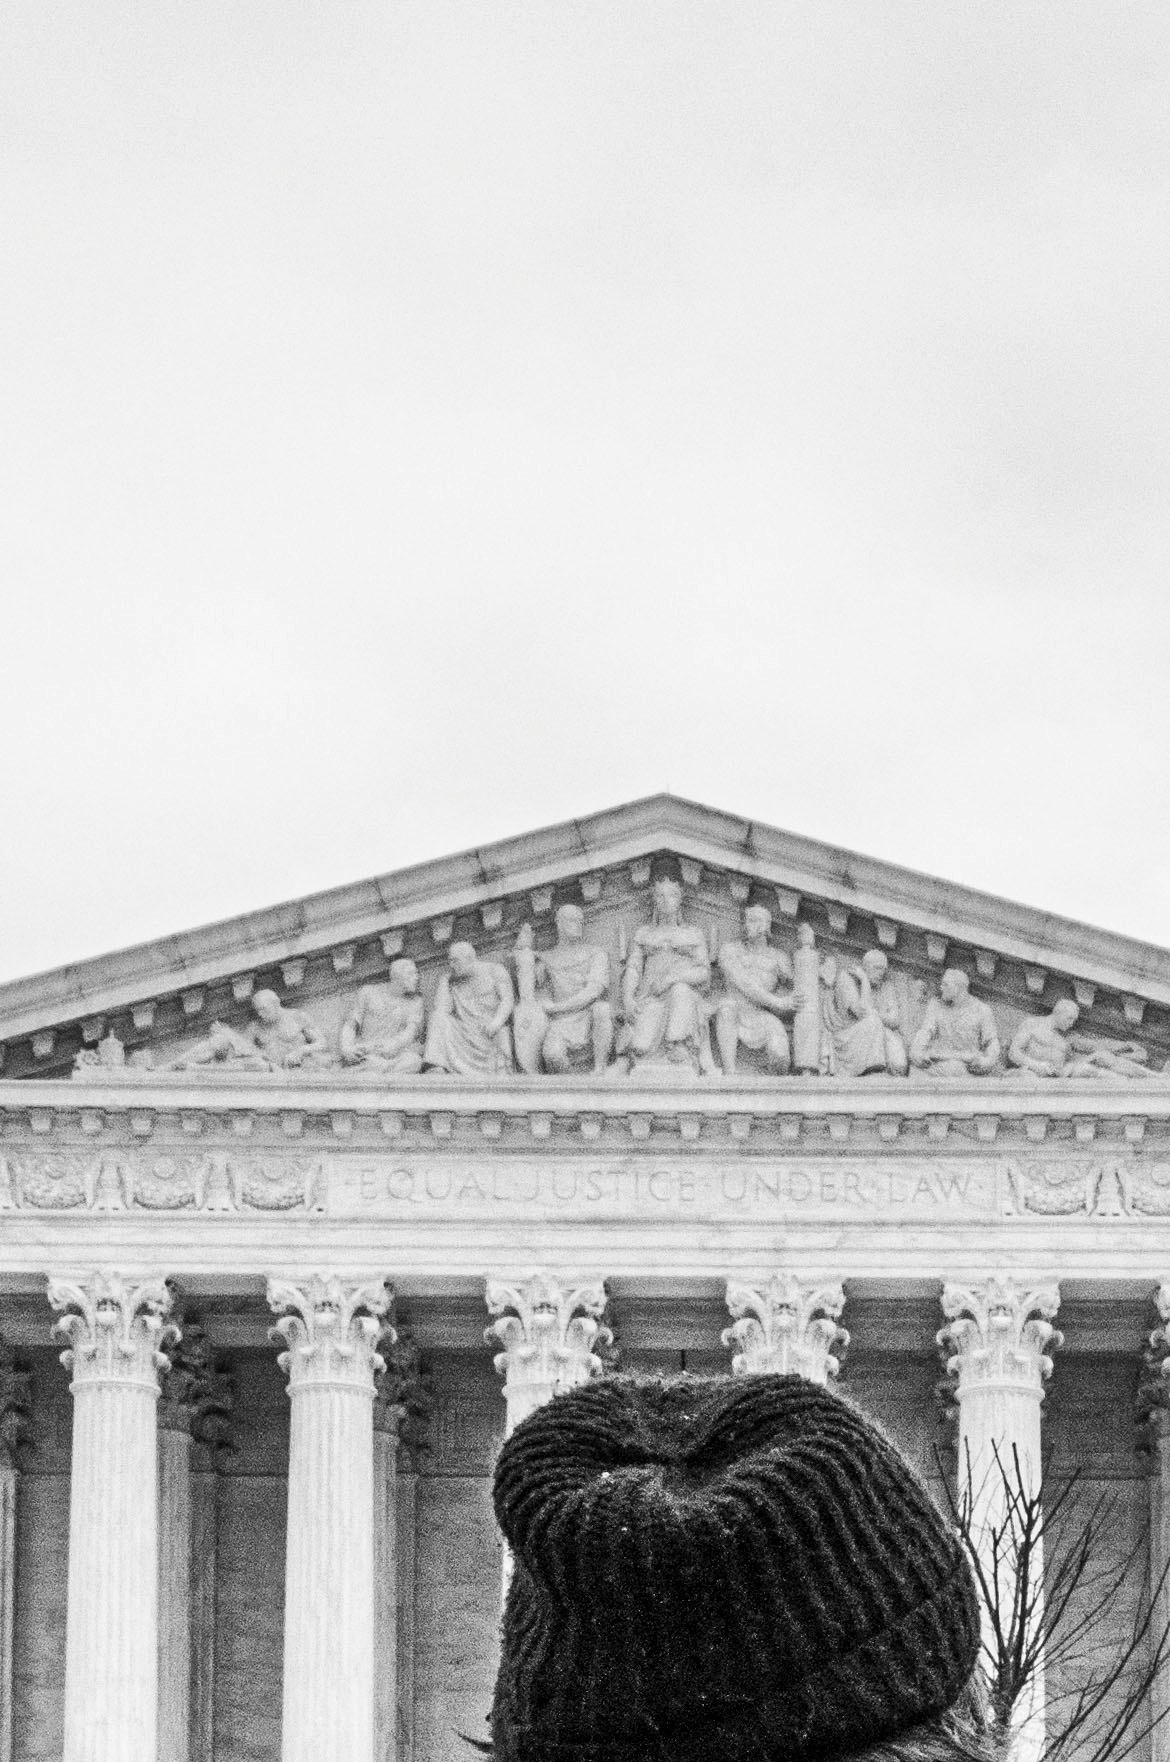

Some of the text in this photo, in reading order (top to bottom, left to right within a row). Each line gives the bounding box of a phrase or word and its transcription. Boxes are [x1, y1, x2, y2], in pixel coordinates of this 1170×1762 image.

[358, 1168, 976, 1204] EQUAL JUSTICE UNDER LAW
